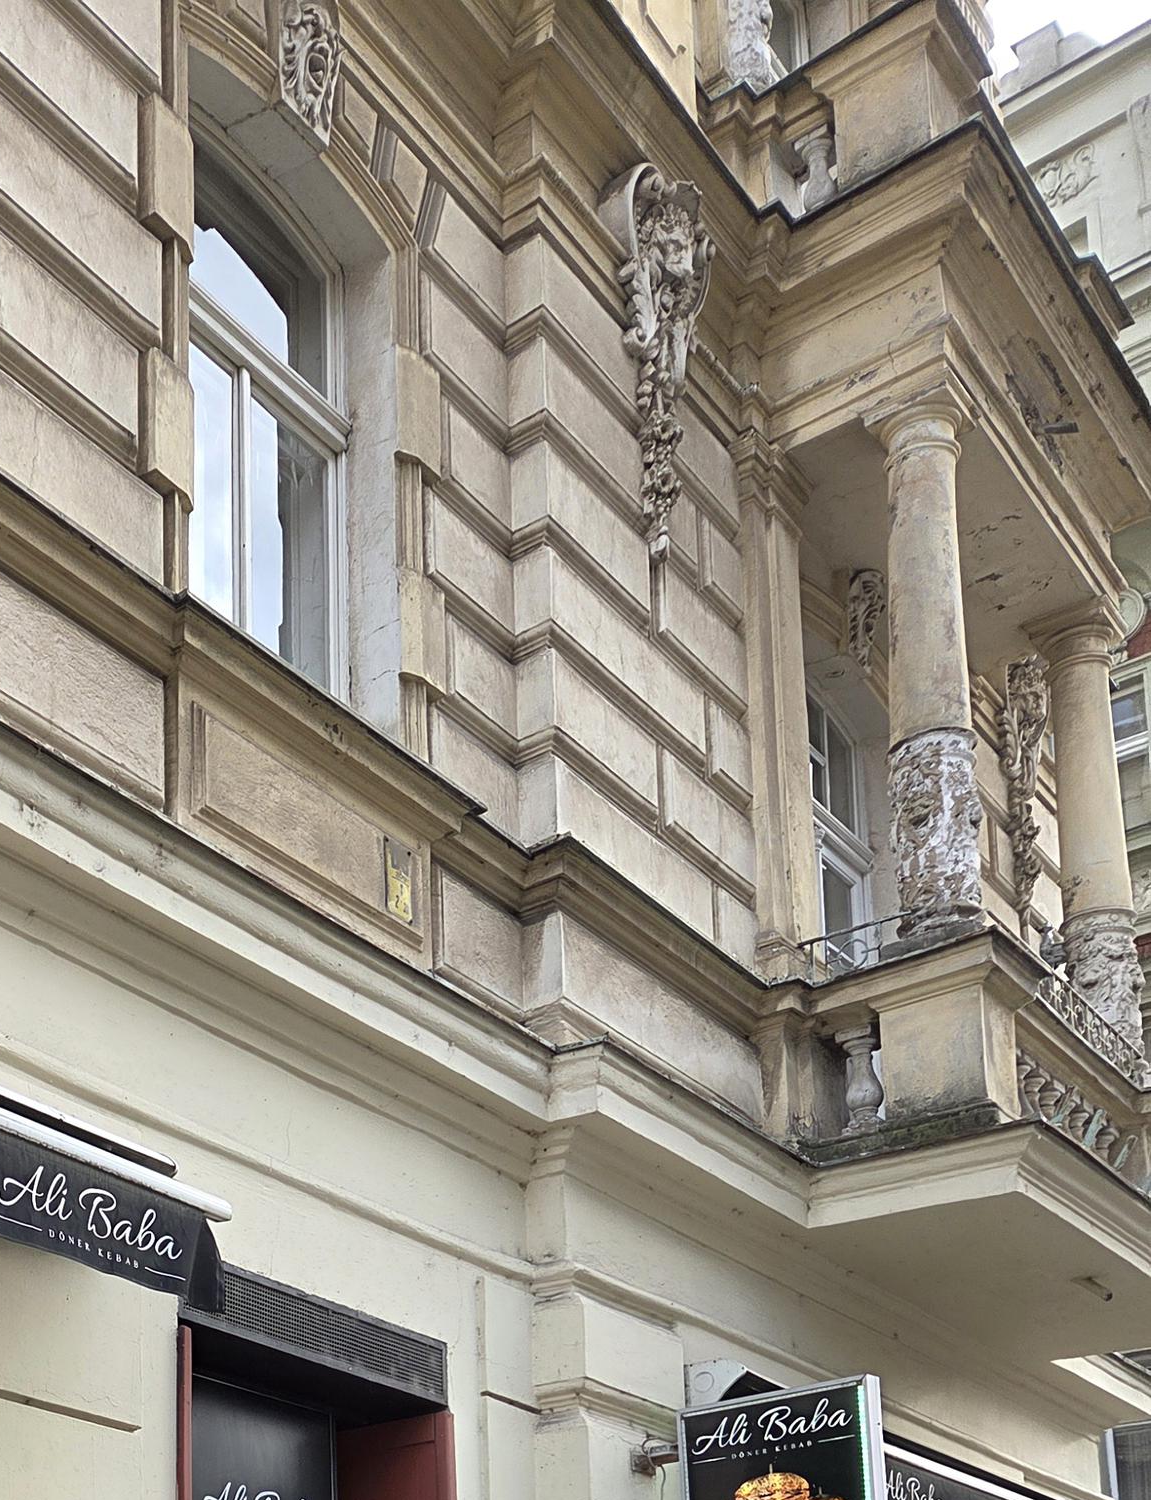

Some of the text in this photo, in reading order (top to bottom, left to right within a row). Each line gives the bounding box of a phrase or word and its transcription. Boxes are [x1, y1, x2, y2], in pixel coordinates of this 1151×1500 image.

[48, 1227, 141, 1270] DÖNER KEBAB
[79, 1187, 183, 1261] Baba
[691, 1398, 853, 1456] Ali Baba
[775, 1440, 813, 1453] KEBAB
